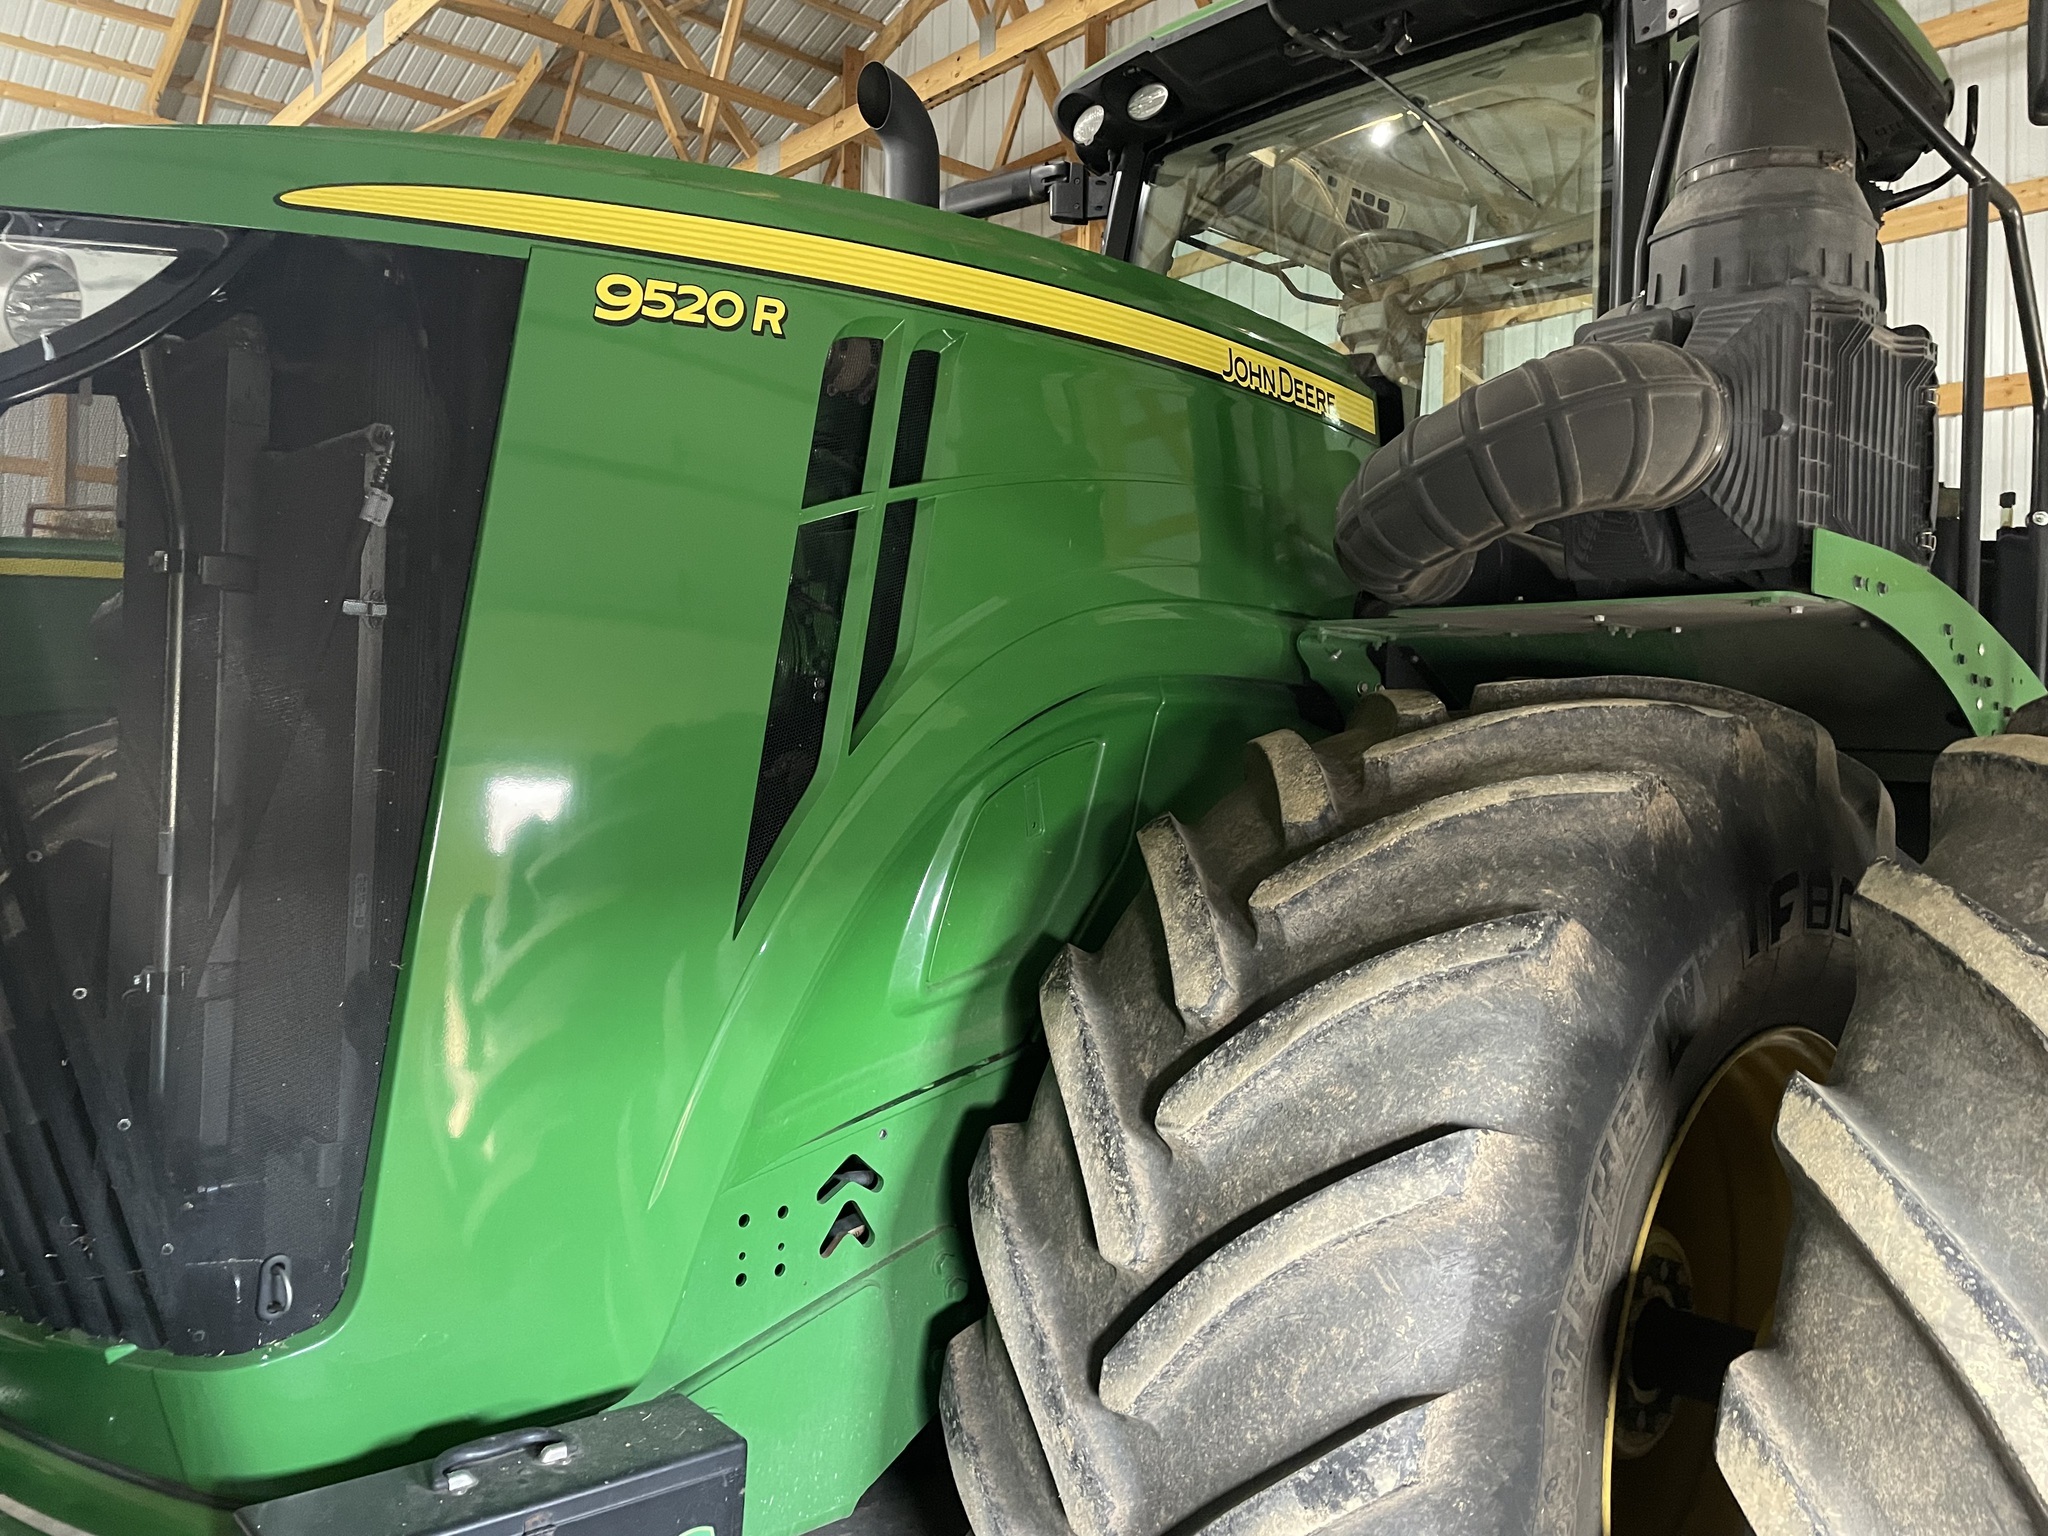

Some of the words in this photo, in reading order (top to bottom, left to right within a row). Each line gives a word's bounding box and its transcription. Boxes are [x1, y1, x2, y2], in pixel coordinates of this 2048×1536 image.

[593, 272, 747, 332] 9520
[751, 295, 788, 339] R
[1222, 347, 1278, 396] JOHN
